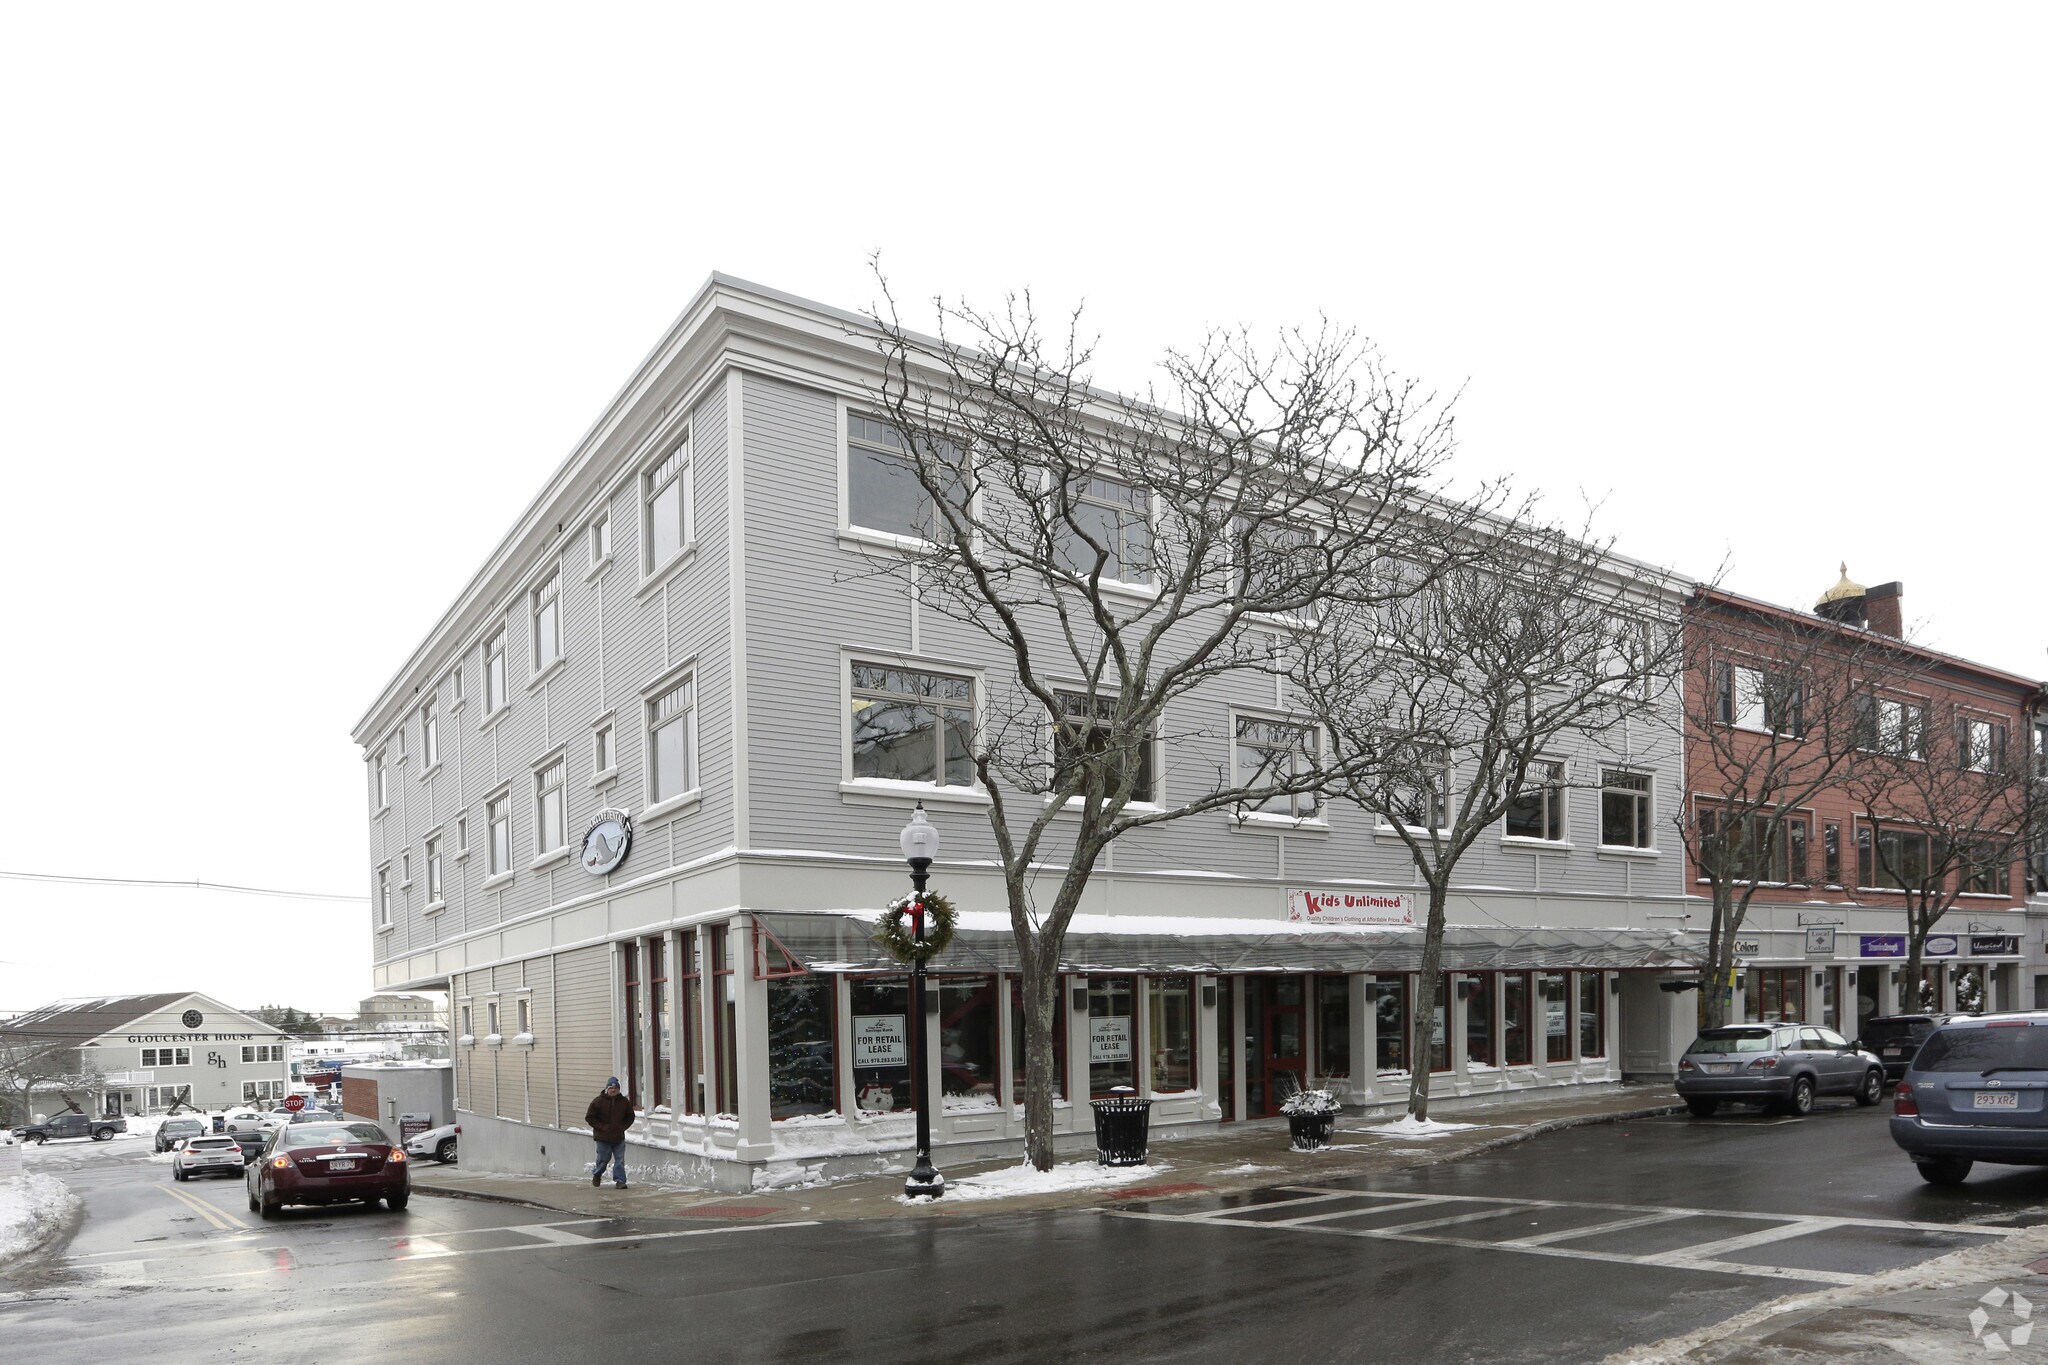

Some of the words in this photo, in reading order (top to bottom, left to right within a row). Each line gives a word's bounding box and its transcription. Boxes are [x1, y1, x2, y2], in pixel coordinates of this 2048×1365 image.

[1304, 891, 1340, 915] Kids
[1344, 895, 1401, 908] Unlimited
[1734, 942, 1758, 953] Colors
[128, 1034, 209, 1043] GLOUCESTER
[857, 1036, 873, 1045] FOR
[876, 1036, 902, 1044] RETAIL
[1092, 1035, 1105, 1043] FOR
[1107, 1034, 1127, 1042] RETAIL
[868, 1045, 892, 1053] LEASE
[285, 1099, 304, 1108] STOP
[1976, 1096, 1995, 1105] 293
[1997, 1095, 2015, 1104] XR2
